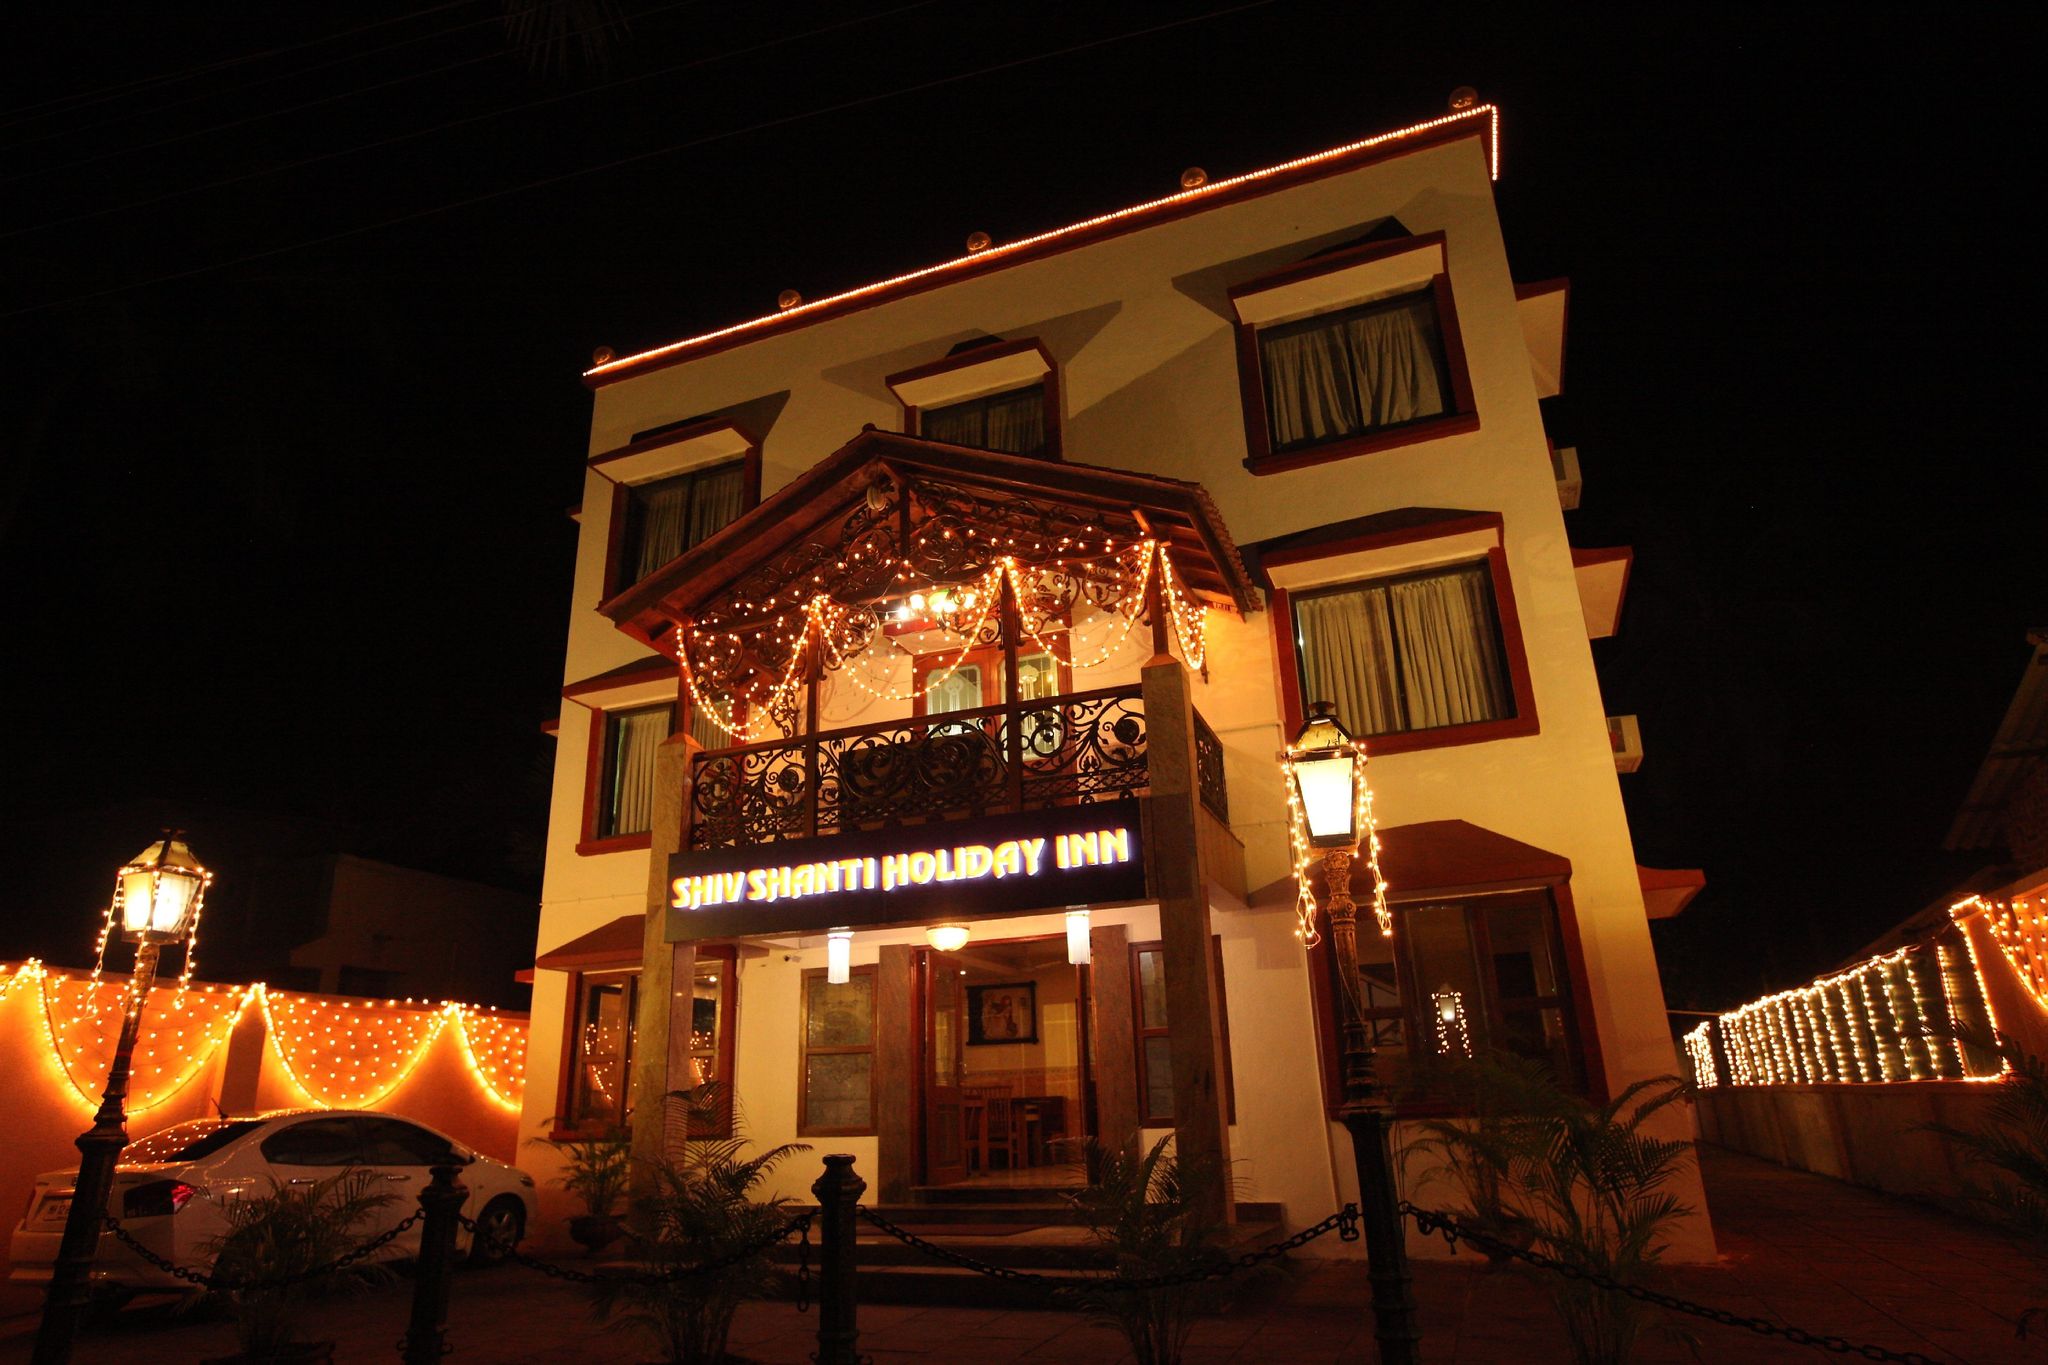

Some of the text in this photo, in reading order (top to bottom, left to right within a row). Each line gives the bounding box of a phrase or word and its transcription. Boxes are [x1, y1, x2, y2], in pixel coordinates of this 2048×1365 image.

[672, 828, 1129, 910] SHIV SHANTI HOLIDAY INN
